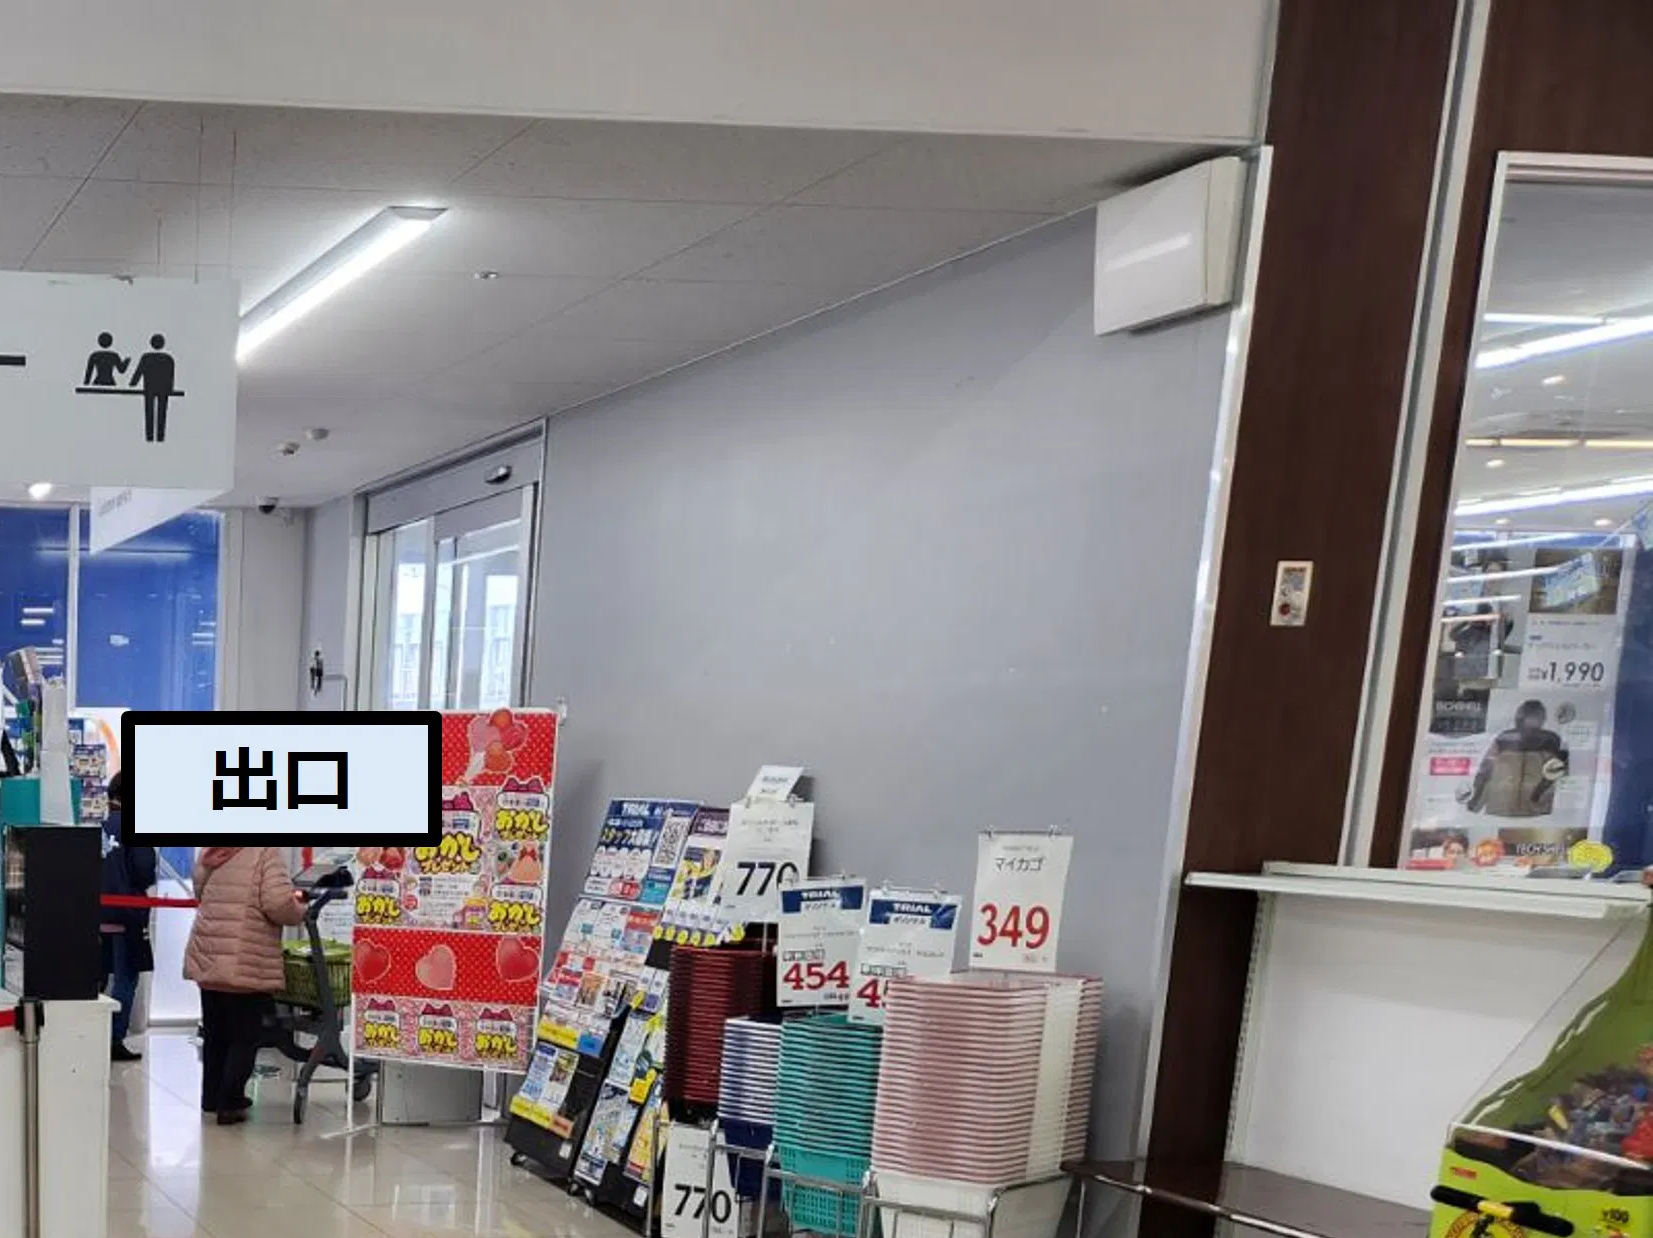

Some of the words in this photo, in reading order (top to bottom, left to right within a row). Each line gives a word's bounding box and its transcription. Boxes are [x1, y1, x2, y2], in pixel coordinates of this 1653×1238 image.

[736, 861, 800, 897] 770
[994, 856, 1045, 872] マイカゴ
[801, 890, 841, 901] TRIAL
[893, 902, 934, 915] TRIAL
[976, 903, 1051, 950] 349
[782, 960, 850, 991] 454
[856, 977, 887, 1009] 4
[674, 1183, 732, 1224] 770
